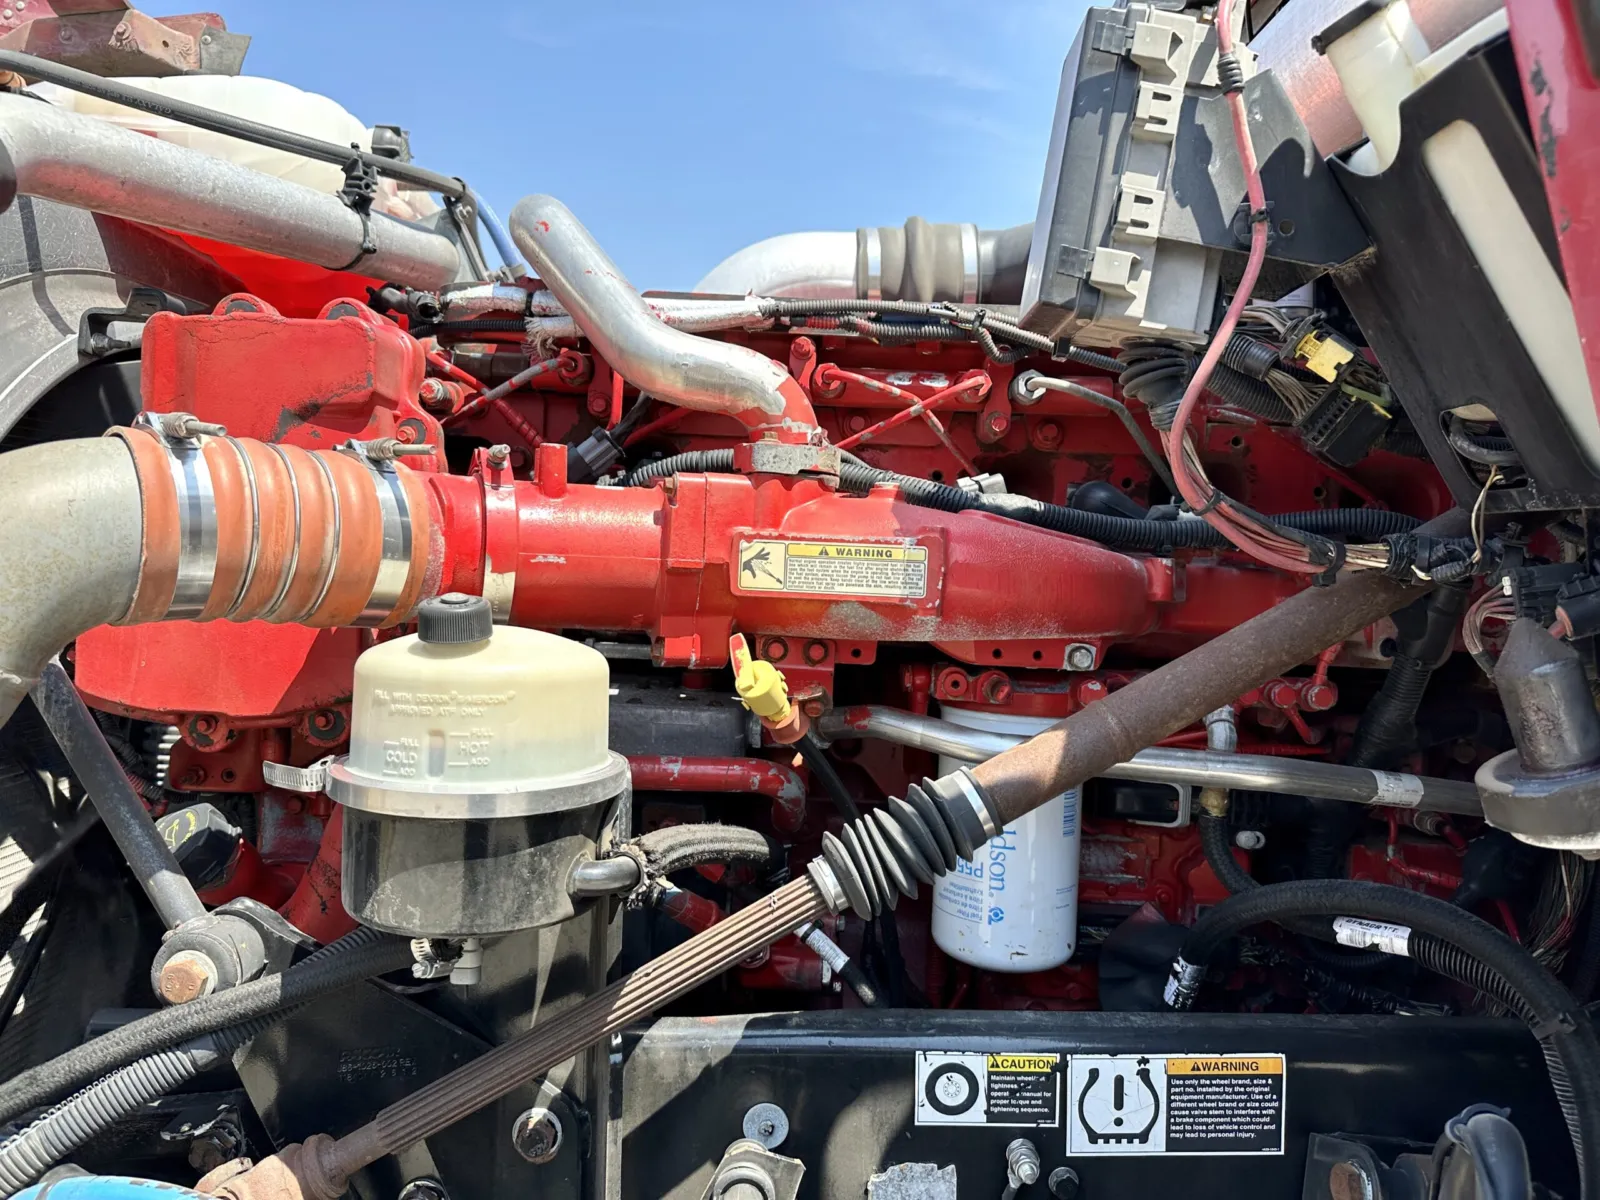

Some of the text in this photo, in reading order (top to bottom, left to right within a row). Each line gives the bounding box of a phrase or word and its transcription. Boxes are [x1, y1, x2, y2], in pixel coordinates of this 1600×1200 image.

[836, 547, 893, 558] WARNING
[470, 727, 495, 738] FULL
[400, 737, 420, 747] FULL
[459, 741, 490, 755] HOT
[385, 750, 418, 764] COLD
[469, 756, 491, 767] ADD
[399, 767, 417, 776] ADD
[957, 857, 984, 878] P55
[1001, 1059, 1054, 1069] CAUTION
[1201, 1061, 1259, 1072] WARNING
